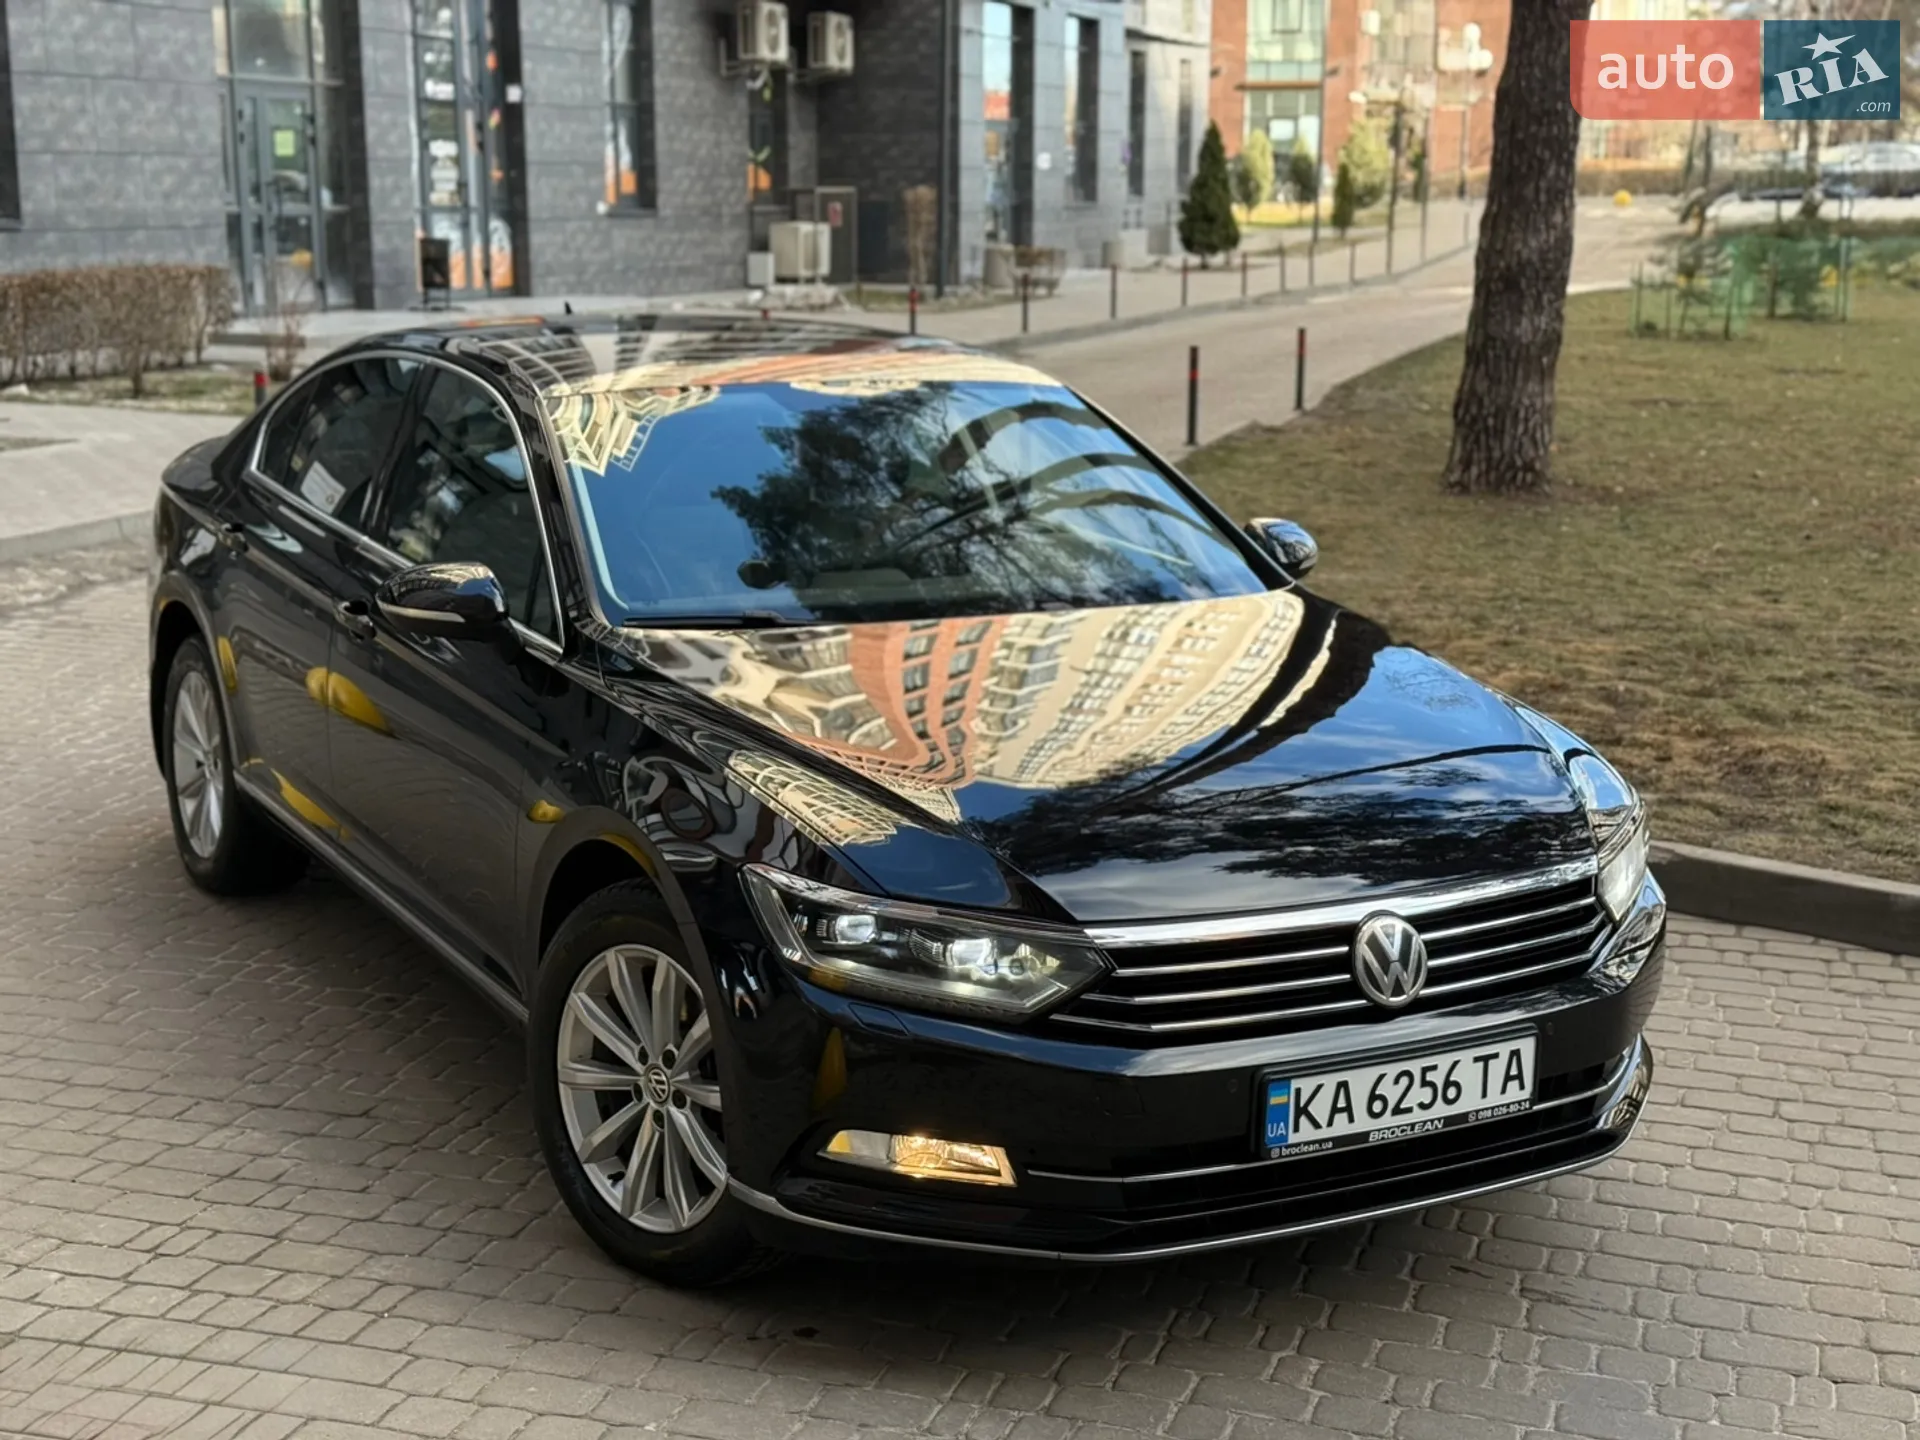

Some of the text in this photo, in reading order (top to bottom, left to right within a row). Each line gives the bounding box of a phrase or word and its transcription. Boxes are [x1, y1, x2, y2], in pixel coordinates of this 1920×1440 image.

[1293, 1048, 1525, 1133] KA 6256 TA
[1267, 1122, 1286, 1137] UA
[1369, 1119, 1444, 1142] BROCLEAN
[1281, 1141, 1333, 1156] broclean.ua
